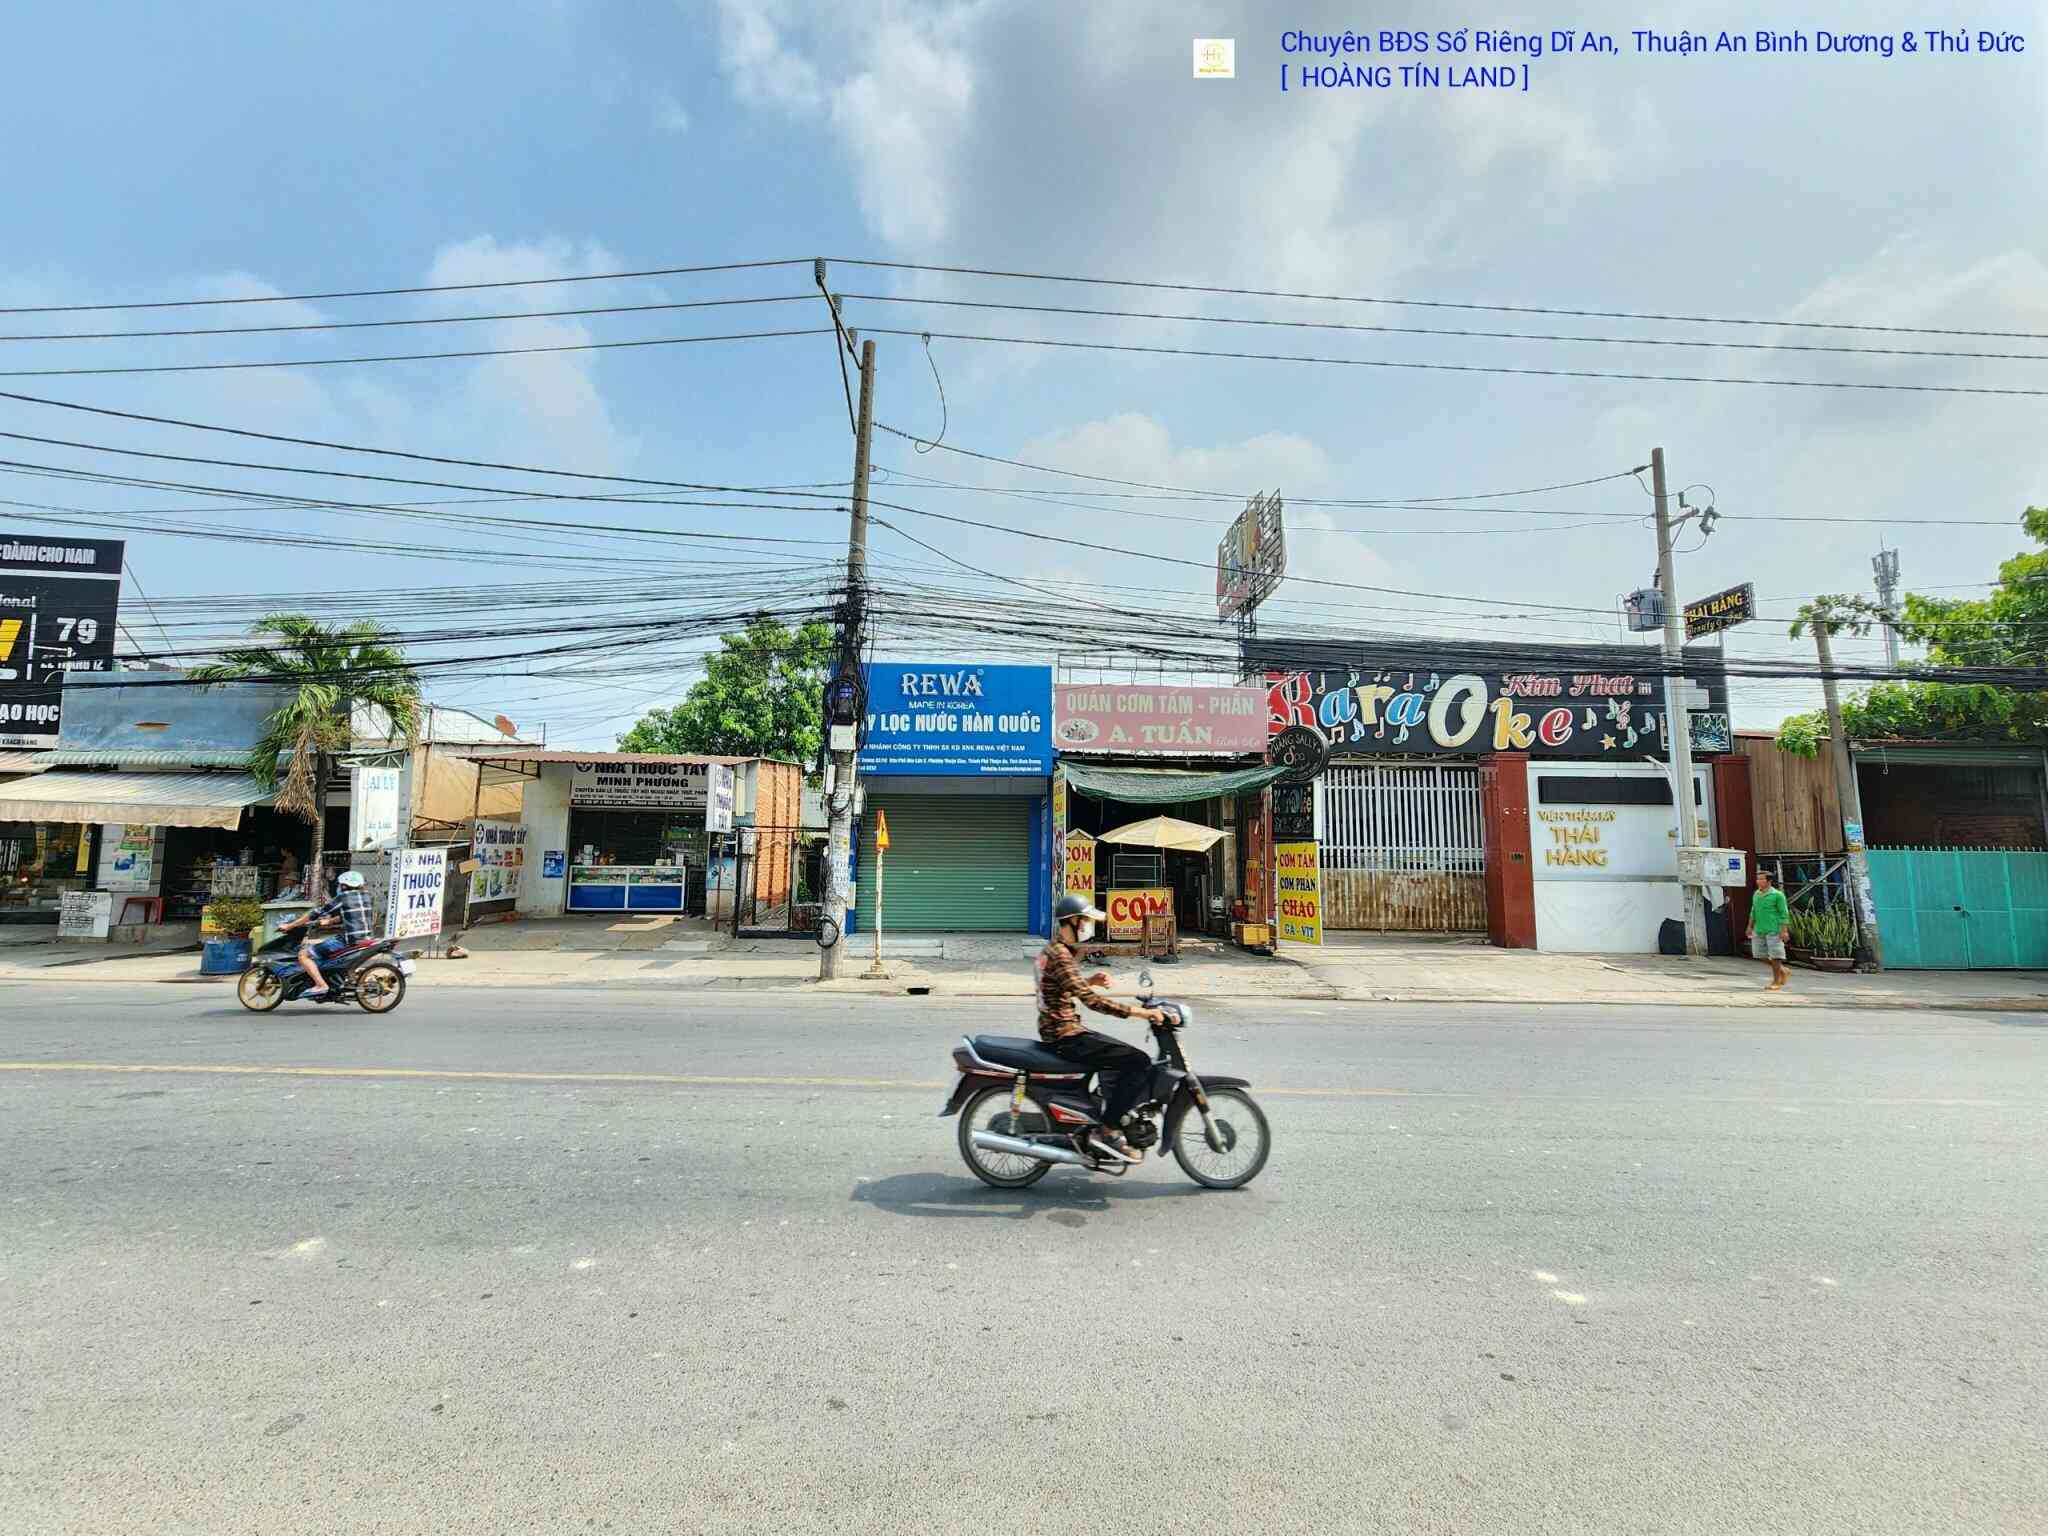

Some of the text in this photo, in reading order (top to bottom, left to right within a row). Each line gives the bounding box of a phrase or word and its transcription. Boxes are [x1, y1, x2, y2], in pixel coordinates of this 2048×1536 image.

[2, 541, 96, 565] DÀNH CHO NAM
[57, 617, 98, 643] 79
[902, 670, 984, 697] REWA
[1500, 673, 1562, 696] Kim
[908, 701, 975, 710] MADE IN KOREA
[1067, 690, 1111, 714] QUÁN
[1116, 692, 1153, 713] CƠM
[1158, 689, 1193, 714] TẤM
[25, 703, 60, 725] HỌC
[881, 713, 910, 735] LỌC
[916, 711, 957, 733] NƯỚC
[962, 712, 994, 733] HÀN
[998, 709, 1041, 733] QUỐC
[1109, 724, 1134, 743] A.
[1140, 717, 1213, 745] TUẤN
[597, 776, 689, 788] MINH PHƯƠNG
[1550, 824, 1601, 844] THÁI
[403, 866, 442, 890] THUỐC
[408, 890, 436, 910] TÂY
[1110, 891, 1169, 922] CƠM
[1282, 895, 1316, 918] CHÁO
